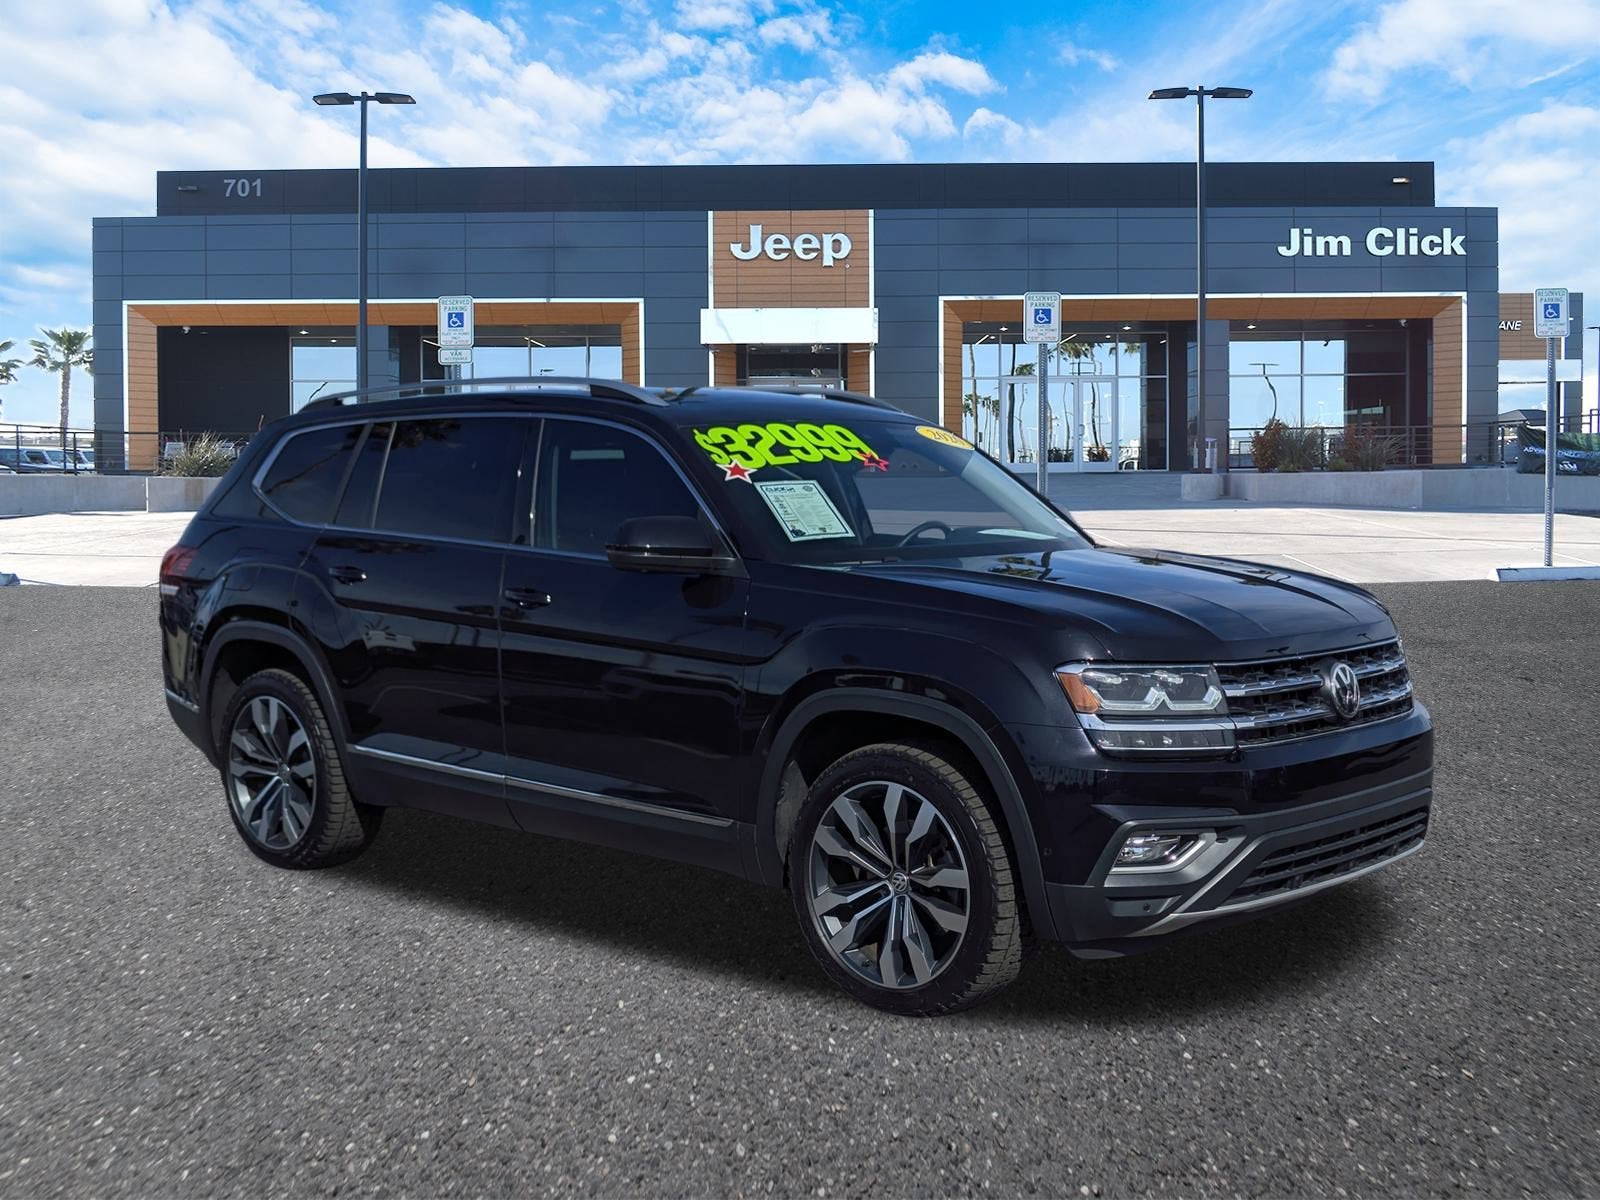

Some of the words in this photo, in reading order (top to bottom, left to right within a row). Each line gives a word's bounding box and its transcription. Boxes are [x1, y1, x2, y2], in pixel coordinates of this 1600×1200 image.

[223, 178, 262, 197] 701
[729, 224, 852, 267] Jeep
[1276, 227, 1352, 257] Jim
[1365, 227, 1467, 256] Click
